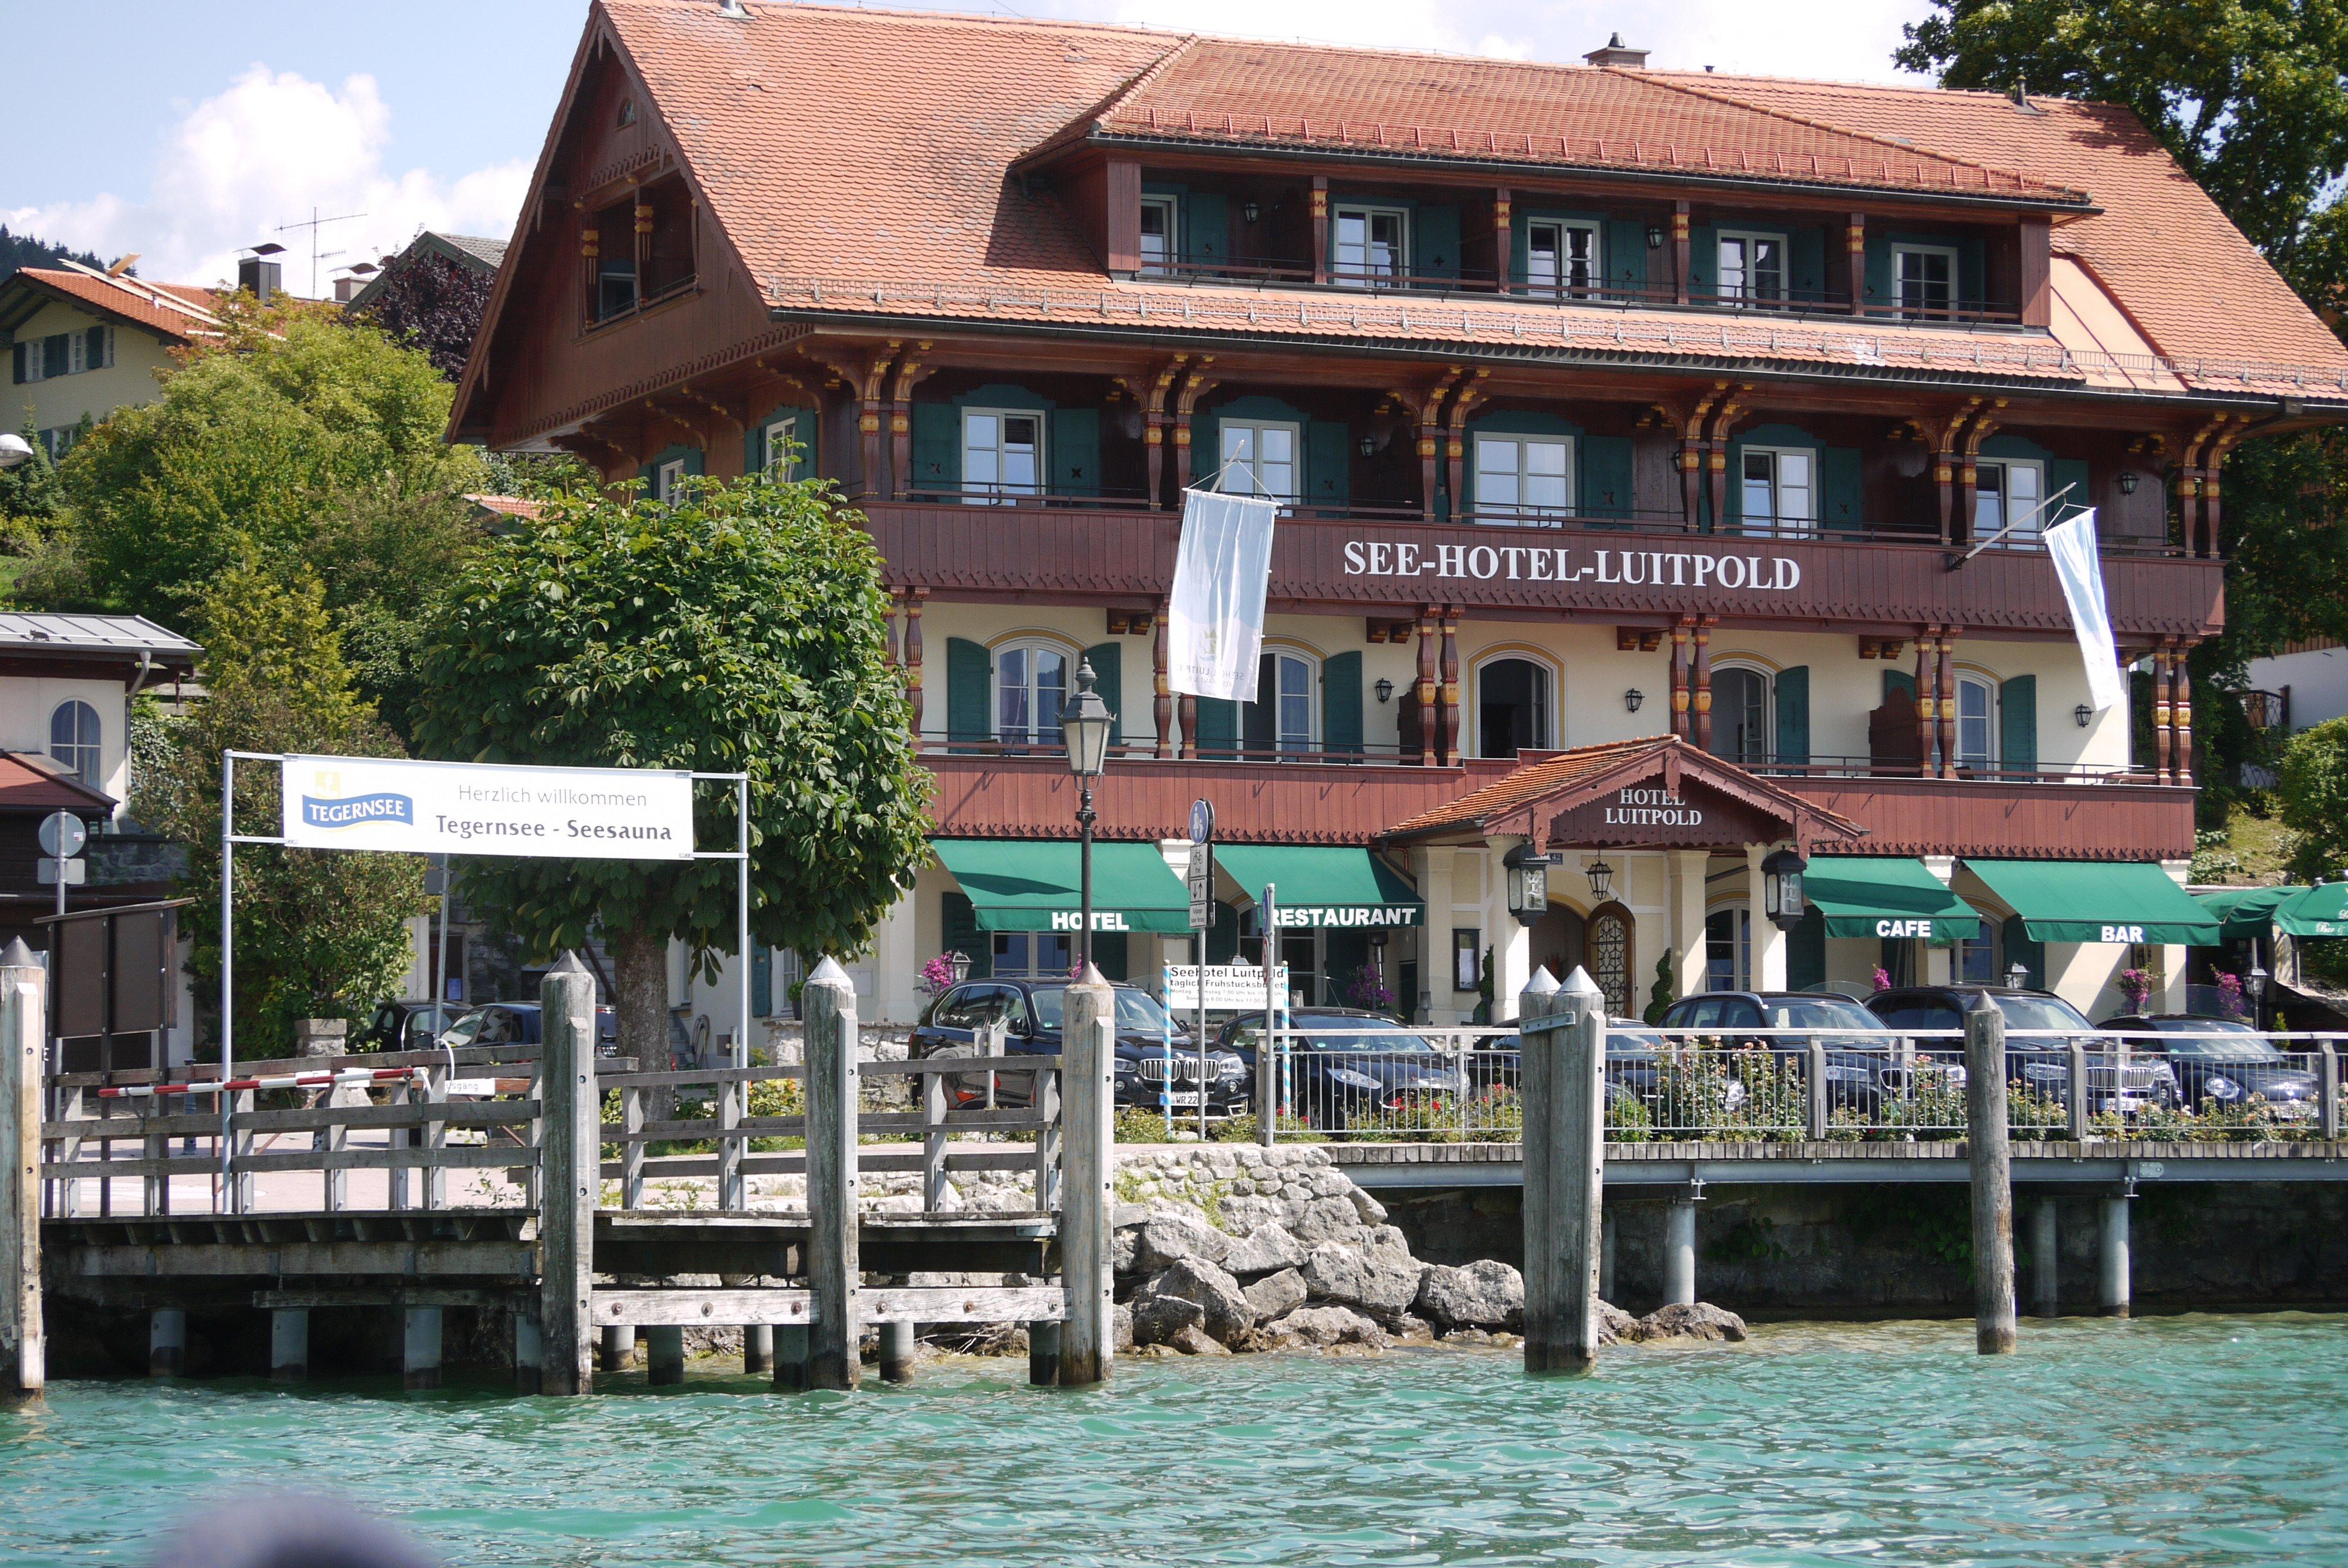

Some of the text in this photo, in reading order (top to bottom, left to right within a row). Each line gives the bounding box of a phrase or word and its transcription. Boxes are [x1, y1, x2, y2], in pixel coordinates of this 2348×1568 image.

[1344, 540, 1800, 590] SEE-HOTEL-LUITPOLD
[459, 785, 647, 806] Herzlich willkommen
[1619, 789, 1685, 806] HOTEL
[309, 799, 405, 822] TEGERNSEE
[1605, 807, 1702, 826] LUITPOLD
[436, 815, 545, 839] Tegernsee
[567, 819, 672, 840] Seesauna
[1051, 911, 1129, 930] HOTEL
[1876, 920, 1931, 937] CAFE
[2101, 925, 2144, 942] BAR
[1233, 968, 1283, 980] Luitpld
[446, 1083, 478, 1091] usgang
